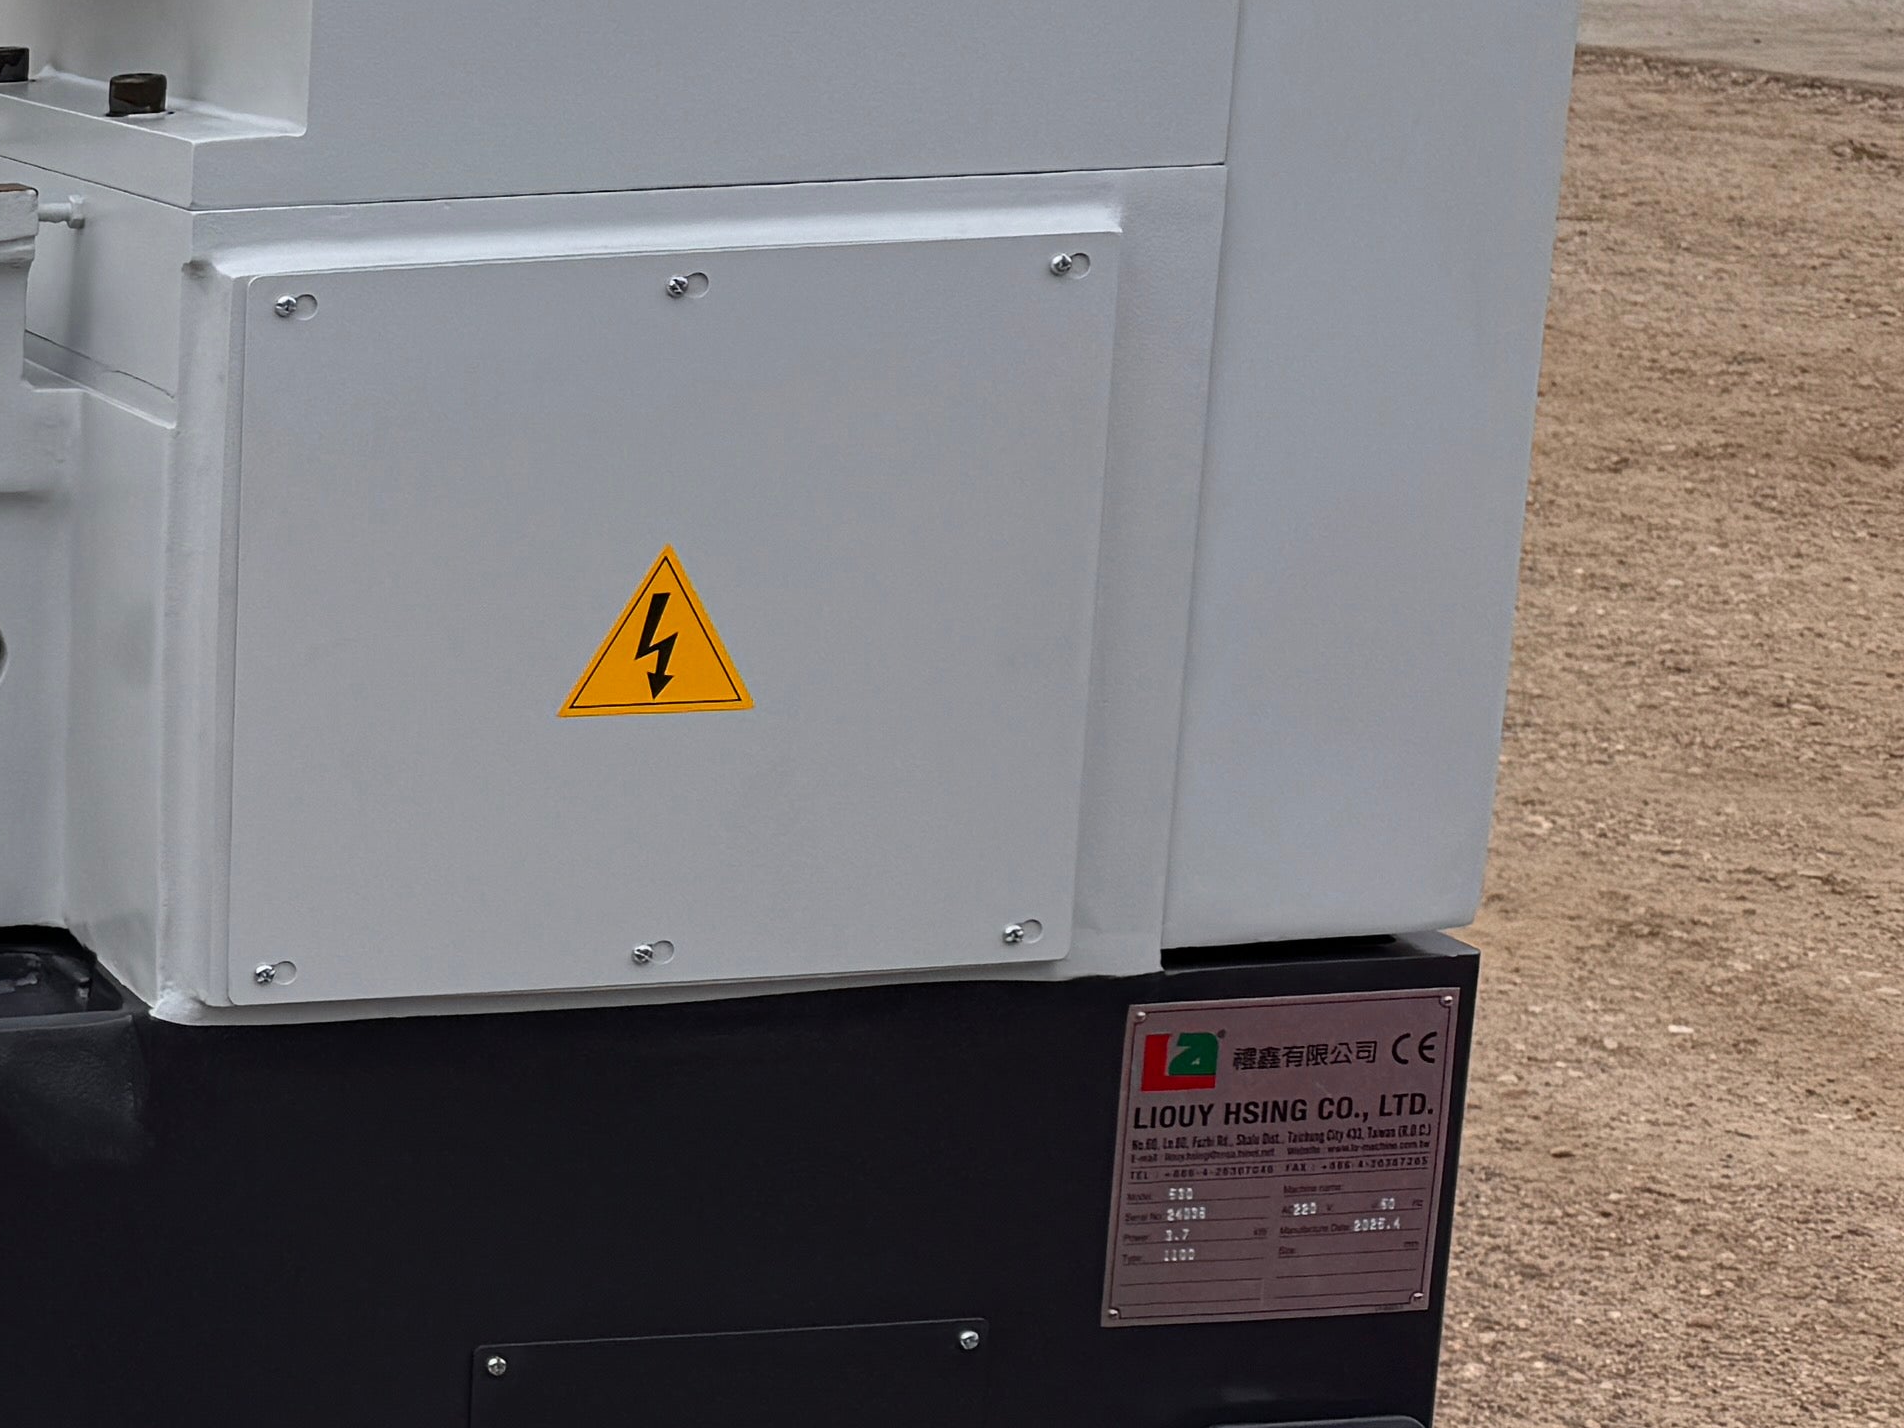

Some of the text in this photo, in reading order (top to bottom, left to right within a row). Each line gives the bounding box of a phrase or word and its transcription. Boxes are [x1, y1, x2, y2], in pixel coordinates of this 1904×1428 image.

[1133, 1092, 1434, 1129] LIOUY HSING CO., LTD.
